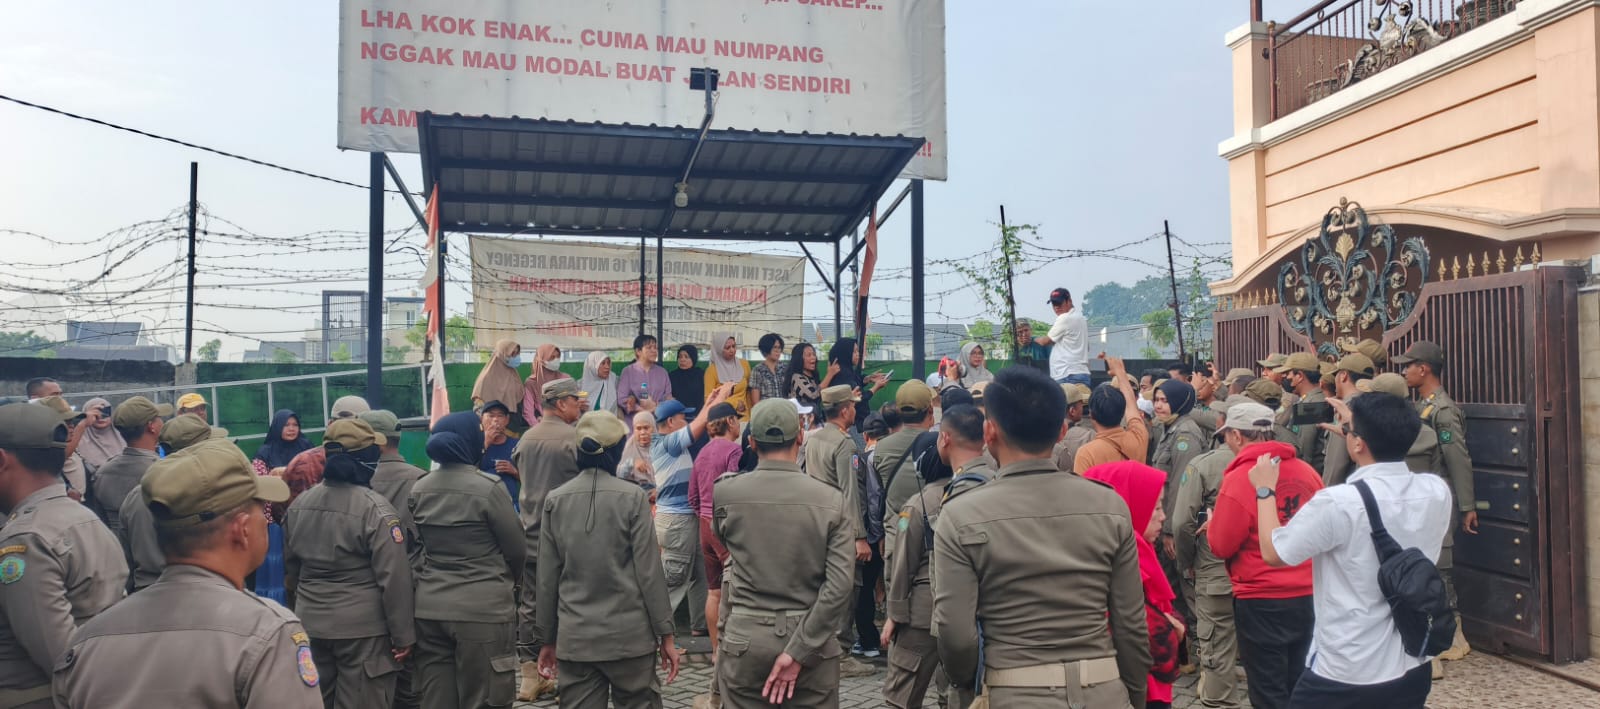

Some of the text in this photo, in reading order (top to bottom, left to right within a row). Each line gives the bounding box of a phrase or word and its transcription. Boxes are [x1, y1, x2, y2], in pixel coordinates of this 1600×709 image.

[360, 9, 824, 64] LHA KOK ENAK... CUMA MAU NUMPANG
[360, 42, 454, 66] NGGAK
[462, 50, 517, 71] MAU
[525, 55, 609, 79] MODAL
[616, 62, 676, 83] BUAT
[763, 73, 851, 95] SENDIRI
[360, 106, 418, 128] KAM
